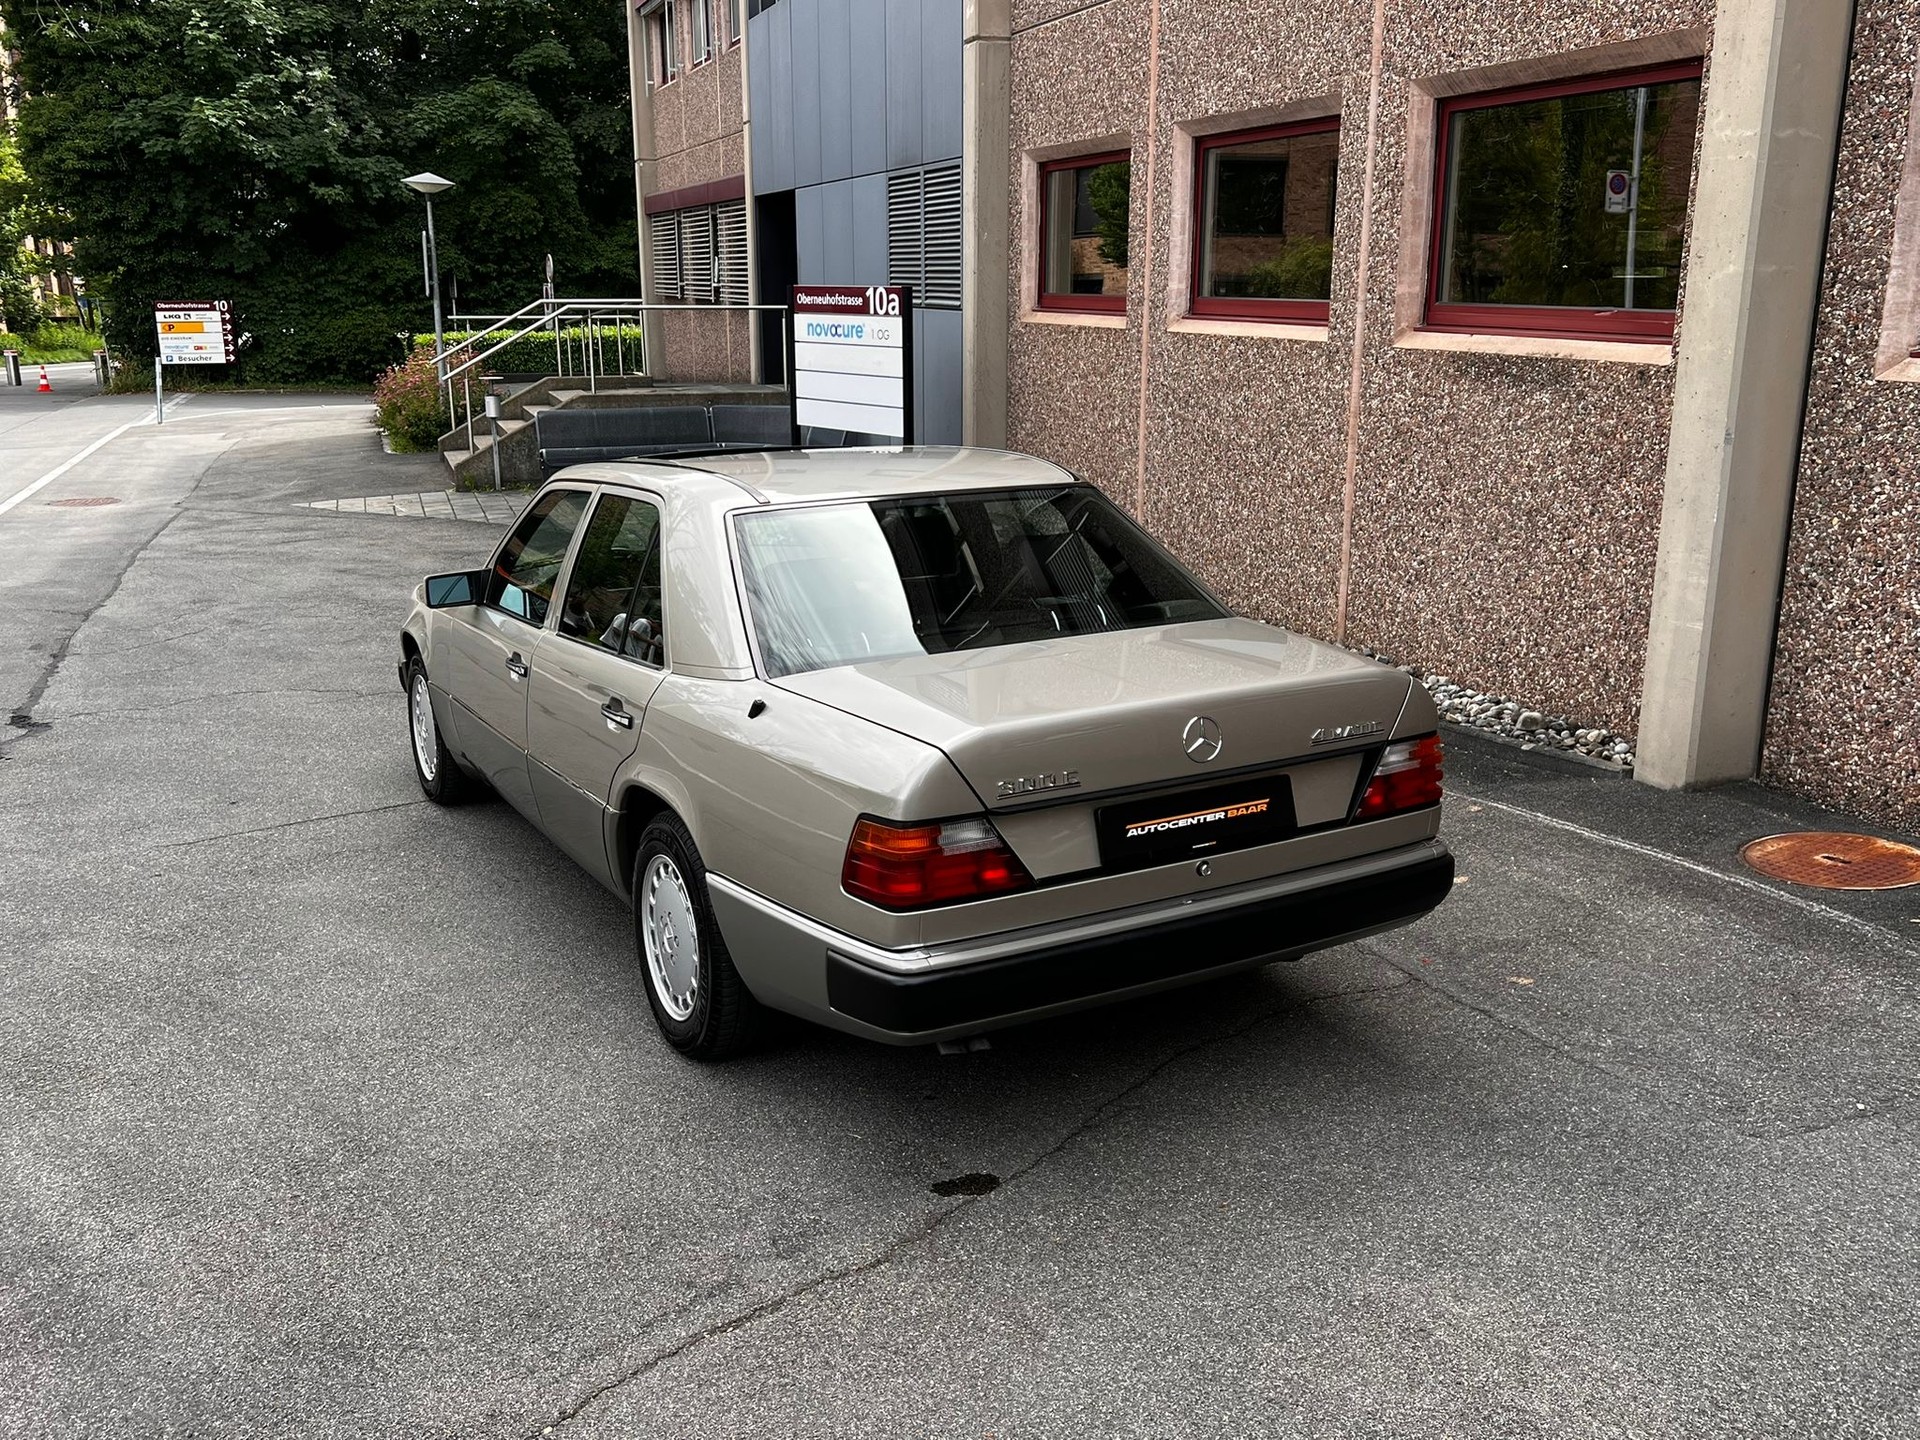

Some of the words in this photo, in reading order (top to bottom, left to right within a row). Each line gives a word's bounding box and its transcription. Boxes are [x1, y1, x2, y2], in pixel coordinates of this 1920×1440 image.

[213, 300, 228, 311] 10
[796, 293, 864, 306] Oberneuhofstrasse
[865, 286, 900, 316] 10a
[877, 329, 890, 341] OG
[998, 774, 1057, 794] 300
[1126, 811, 1226, 838] AUTOCENTER
[1227, 803, 1268, 818] BAAR
